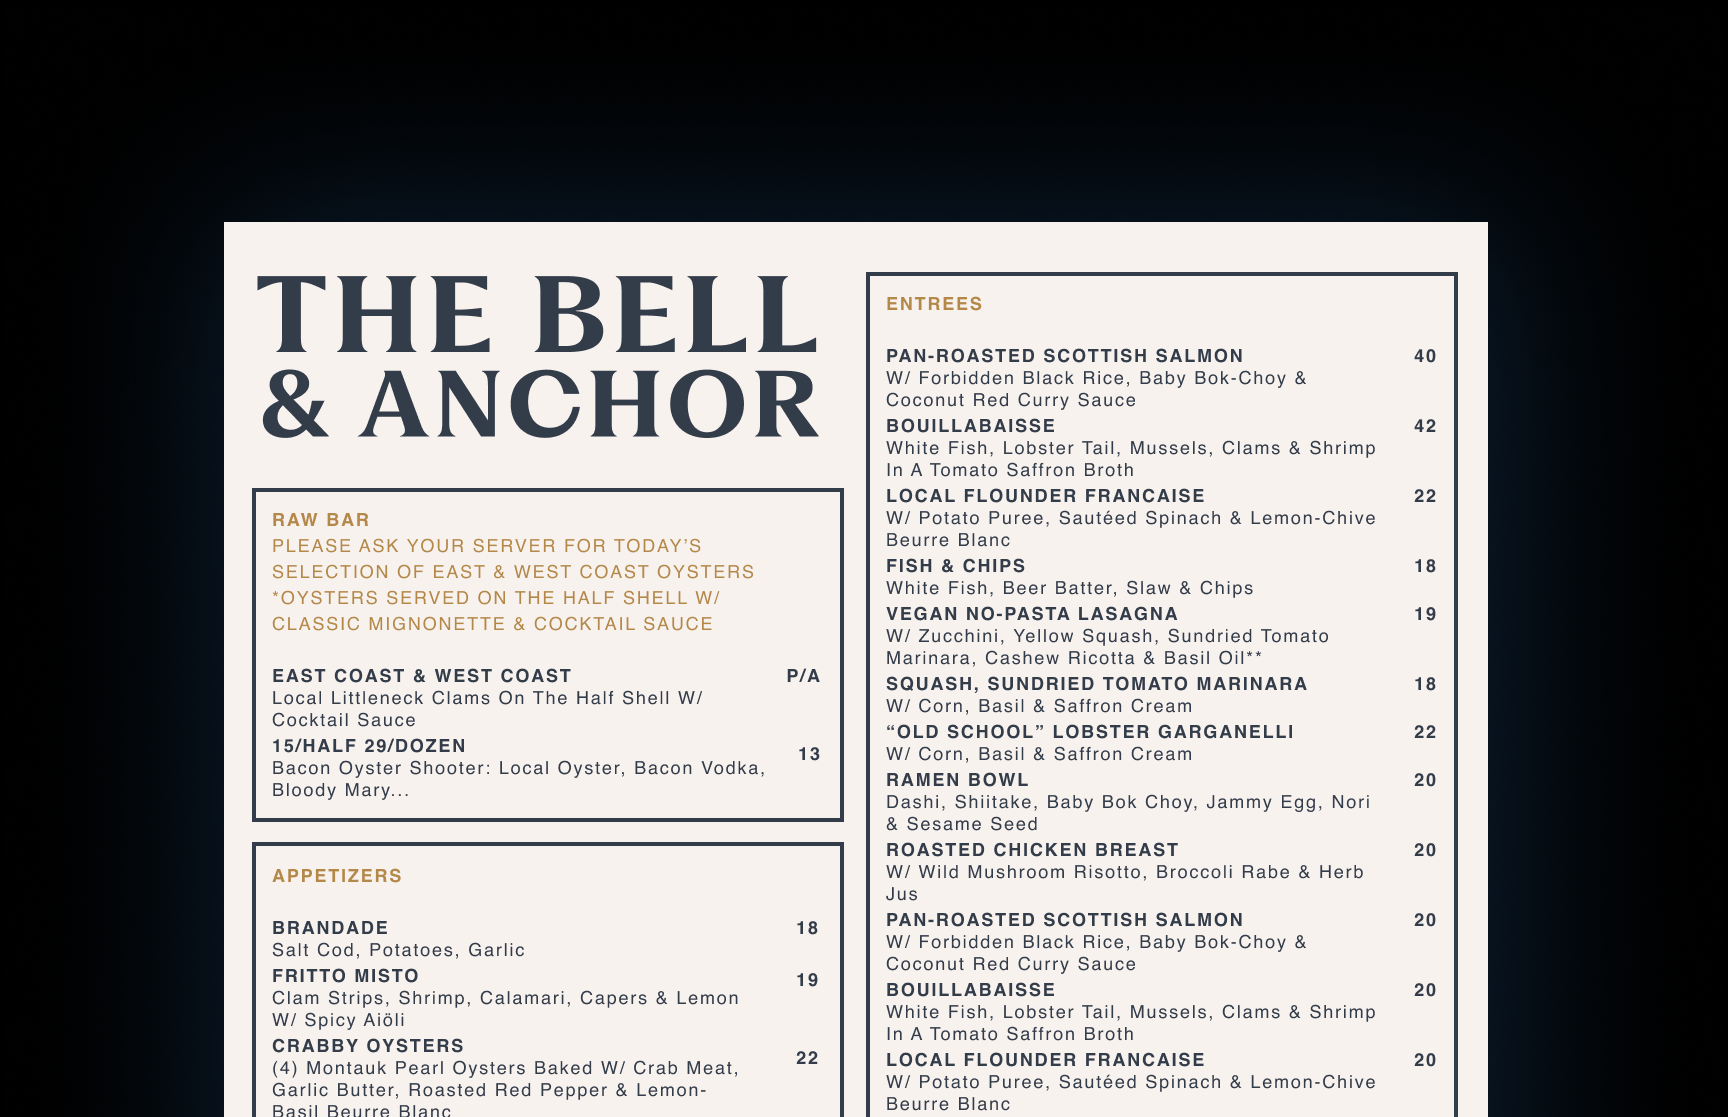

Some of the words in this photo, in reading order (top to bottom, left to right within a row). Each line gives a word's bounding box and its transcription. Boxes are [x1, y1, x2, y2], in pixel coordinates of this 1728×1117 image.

[886, 295, 982, 312] ENTREES
[256, 275, 491, 353] THE
[533, 275, 817, 353] BELL
[886, 347, 1035, 364] PAN-ROASTED
[1043, 347, 1147, 364] SCOTTISH
[1155, 347, 1243, 364] SALMON
[1413, 348, 1437, 364] 40
[885, 370, 911, 385] W/
[919, 370, 1014, 386] Forbidden
[1023, 370, 1075, 386] Black
[1083, 370, 1130, 388] Rice,
[1139, 370, 1186, 389] Baby
[1194, 369, 1287, 389] Bok-Choy
[1294, 370, 1307, 386] &
[262, 368, 330, 439] &
[357, 368, 820, 439] ANCHOR
[886, 417, 1055, 434] BOUILLABAISSE
[1413, 418, 1437, 433] 42
[886, 487, 956, 504] LOCAL
[964, 487, 1076, 504] FLOUNDER
[1085, 487, 1205, 504] FRANCAISE
[1413, 488, 1437, 503] 22
[272, 512, 318, 527] RAW
[326, 512, 369, 527] BAR
[272, 538, 351, 554] PLEASE
[358, 538, 399, 554] ASK
[406, 538, 464, 554] YOUR
[472, 538, 556, 554] SERVER
[564, 538, 606, 554] FOR
[885, 605, 957, 622] VEGAN
[966, 605, 1071, 622] NO-PASTA
[1078, 605, 1178, 622] LASAGNA
[1414, 606, 1437, 622] 19
[272, 616, 360, 632] CLASSIC
[369, 616, 505, 632] MIGNONETTE
[513, 616, 526, 631] &
[534, 616, 636, 632] COCKTAIL
[643, 616, 713, 632] SAUCE
[272, 667, 327, 684] EAST
[334, 667, 405, 684] COAST
[413, 668, 426, 684] &
[434, 667, 493, 684] WEST
[500, 667, 572, 684] COAST
[786, 667, 821, 683] P/A
[272, 737, 357, 754] 15/HALF
[364, 737, 465, 754] 29/DOZEN
[798, 746, 821, 762] 13
[886, 772, 959, 787] RAMEN
[968, 771, 1029, 788] BOWL
[1413, 772, 1437, 788] 20
[271, 868, 402, 884] APPETIZERS
[272, 920, 388, 935] BRANDADE
[796, 920, 819, 936] 18
[272, 941, 309, 958] Salt
[317, 941, 360, 960] Cod,
[369, 942, 459, 960] Potatoes,
[468, 941, 525, 958] Garlic
[272, 1038, 359, 1054] CRABBY
[366, 1037, 464, 1054] OYSTERS
[795, 1050, 819, 1065] 22
